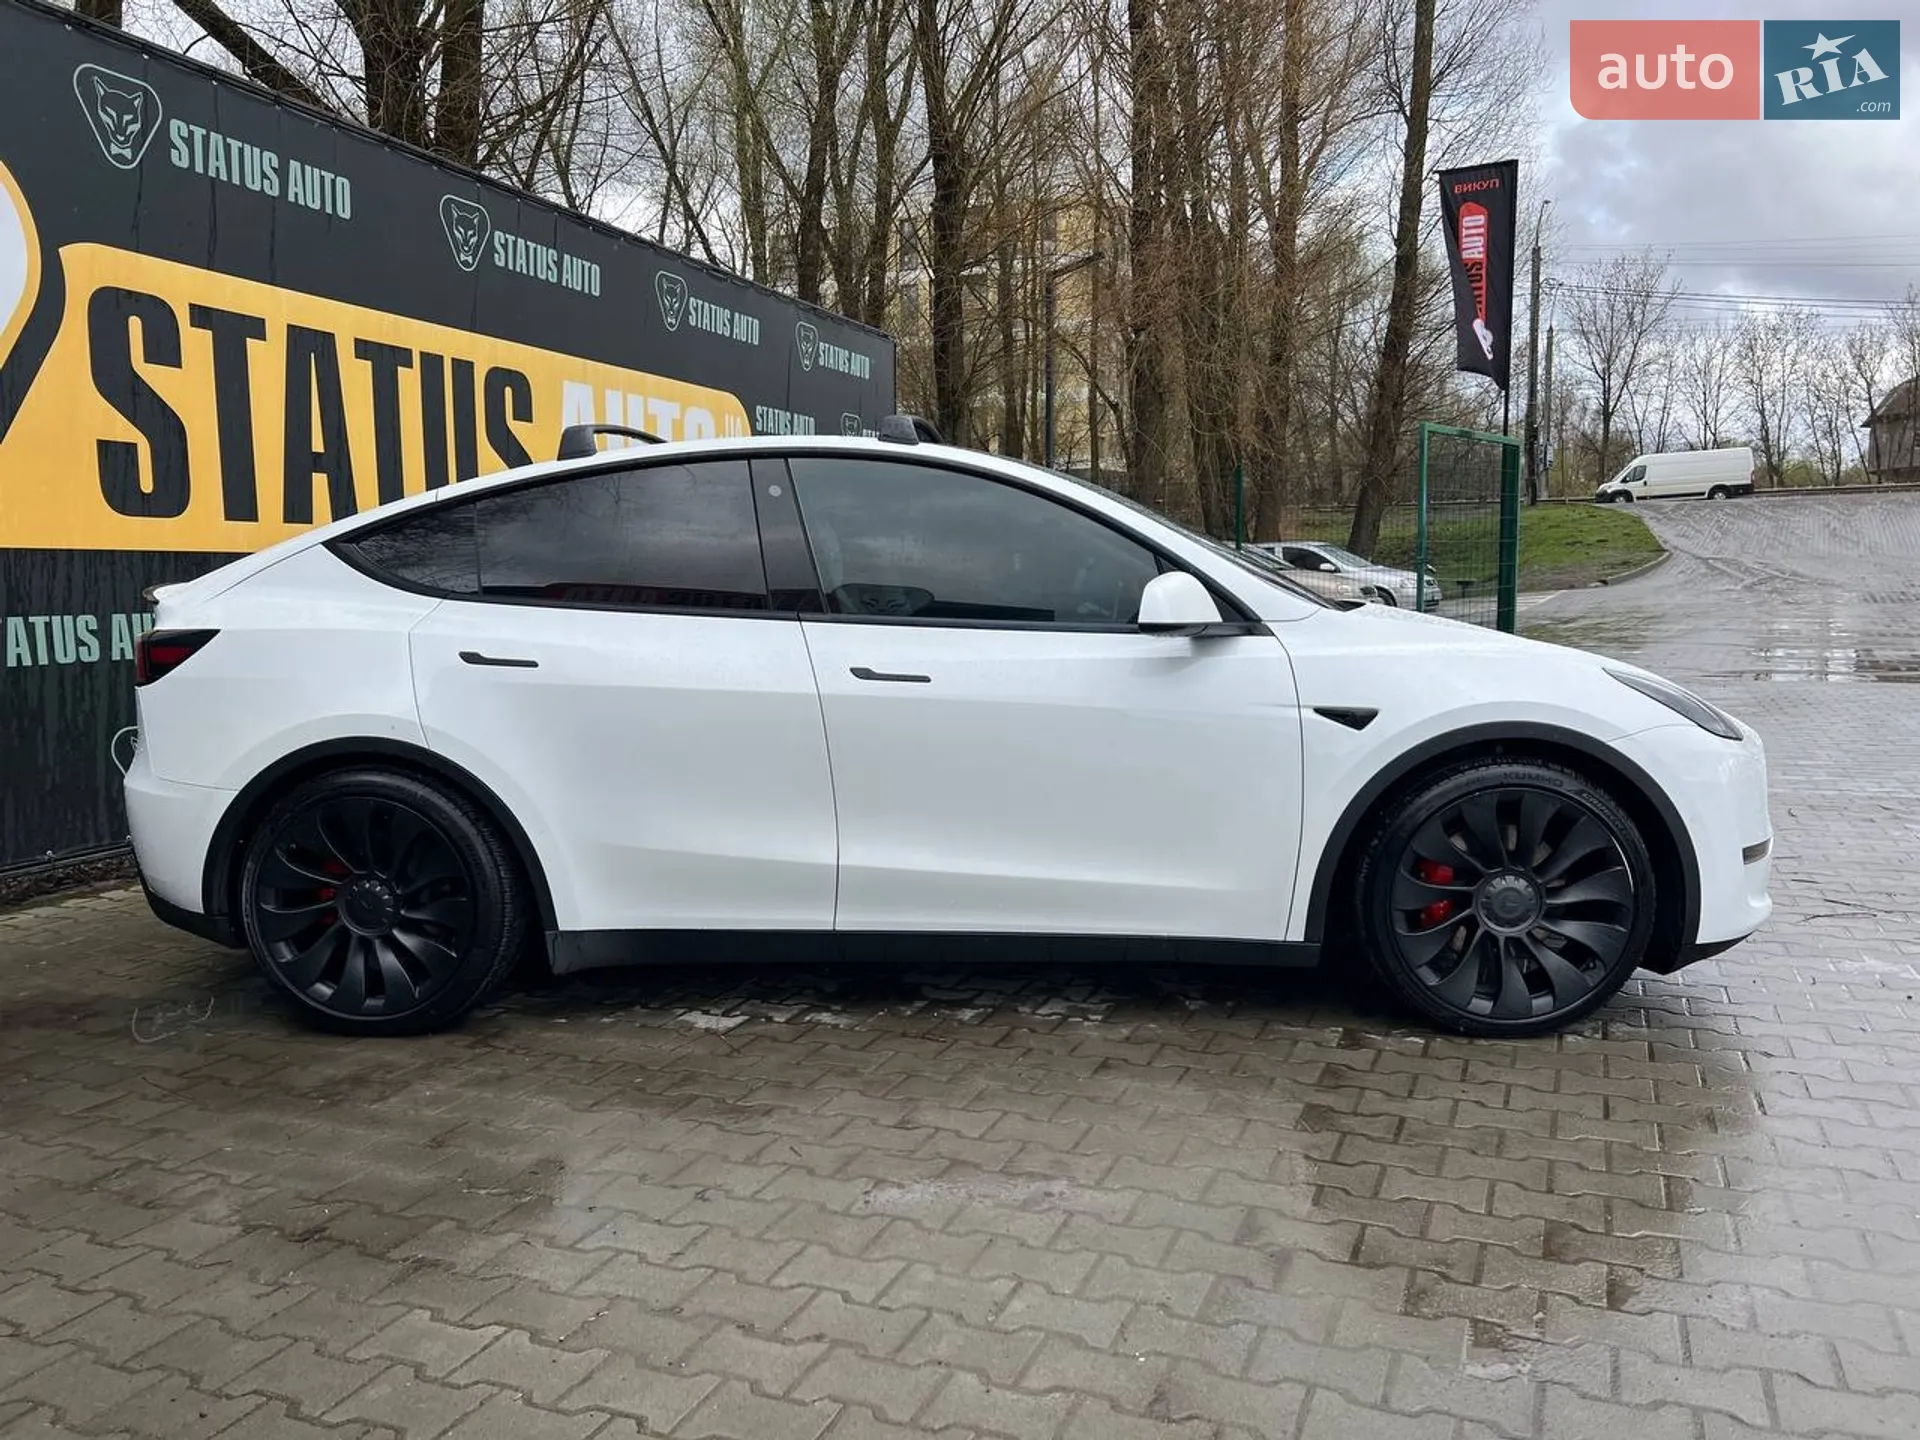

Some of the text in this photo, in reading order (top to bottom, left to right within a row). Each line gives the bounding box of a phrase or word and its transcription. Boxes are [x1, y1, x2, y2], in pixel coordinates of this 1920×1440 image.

[169, 118, 352, 221] STATUS AUTO
[1453, 178, 1500, 195] ВИКУП
[1462, 214, 1486, 260] AUTO
[493, 230, 601, 297] STATUS AUTO
[688, 296, 760, 346] STATUS AUTO
[818, 341, 870, 380] STATUS AUTO
[87, 285, 534, 525] STATUS
[755, 404, 816, 437] STATUS AUTO
[0, 614, 101, 668] ATUS
